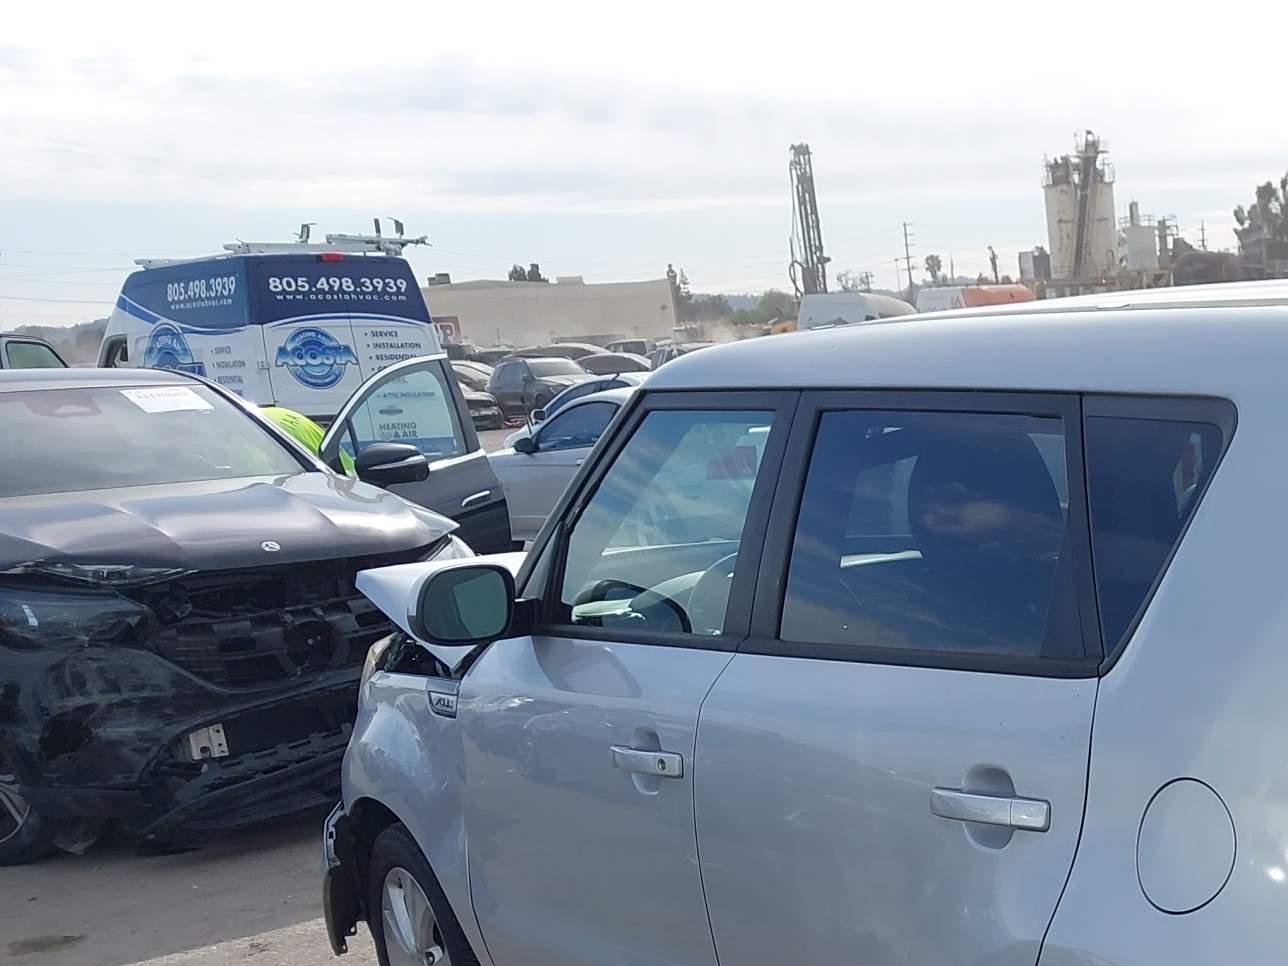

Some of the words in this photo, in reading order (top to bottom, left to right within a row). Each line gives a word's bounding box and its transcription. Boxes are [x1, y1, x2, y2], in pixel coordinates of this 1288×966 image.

[167, 276, 236, 302] 805.498.3939
[268, 276, 407, 293] 805.498.3939
[275, 293, 407, 301] www.acostahvac.com
[275, 345, 360, 368] ACOSTA
[379, 422, 417, 431] HEATING
[402, 430, 418, 438] AIR
